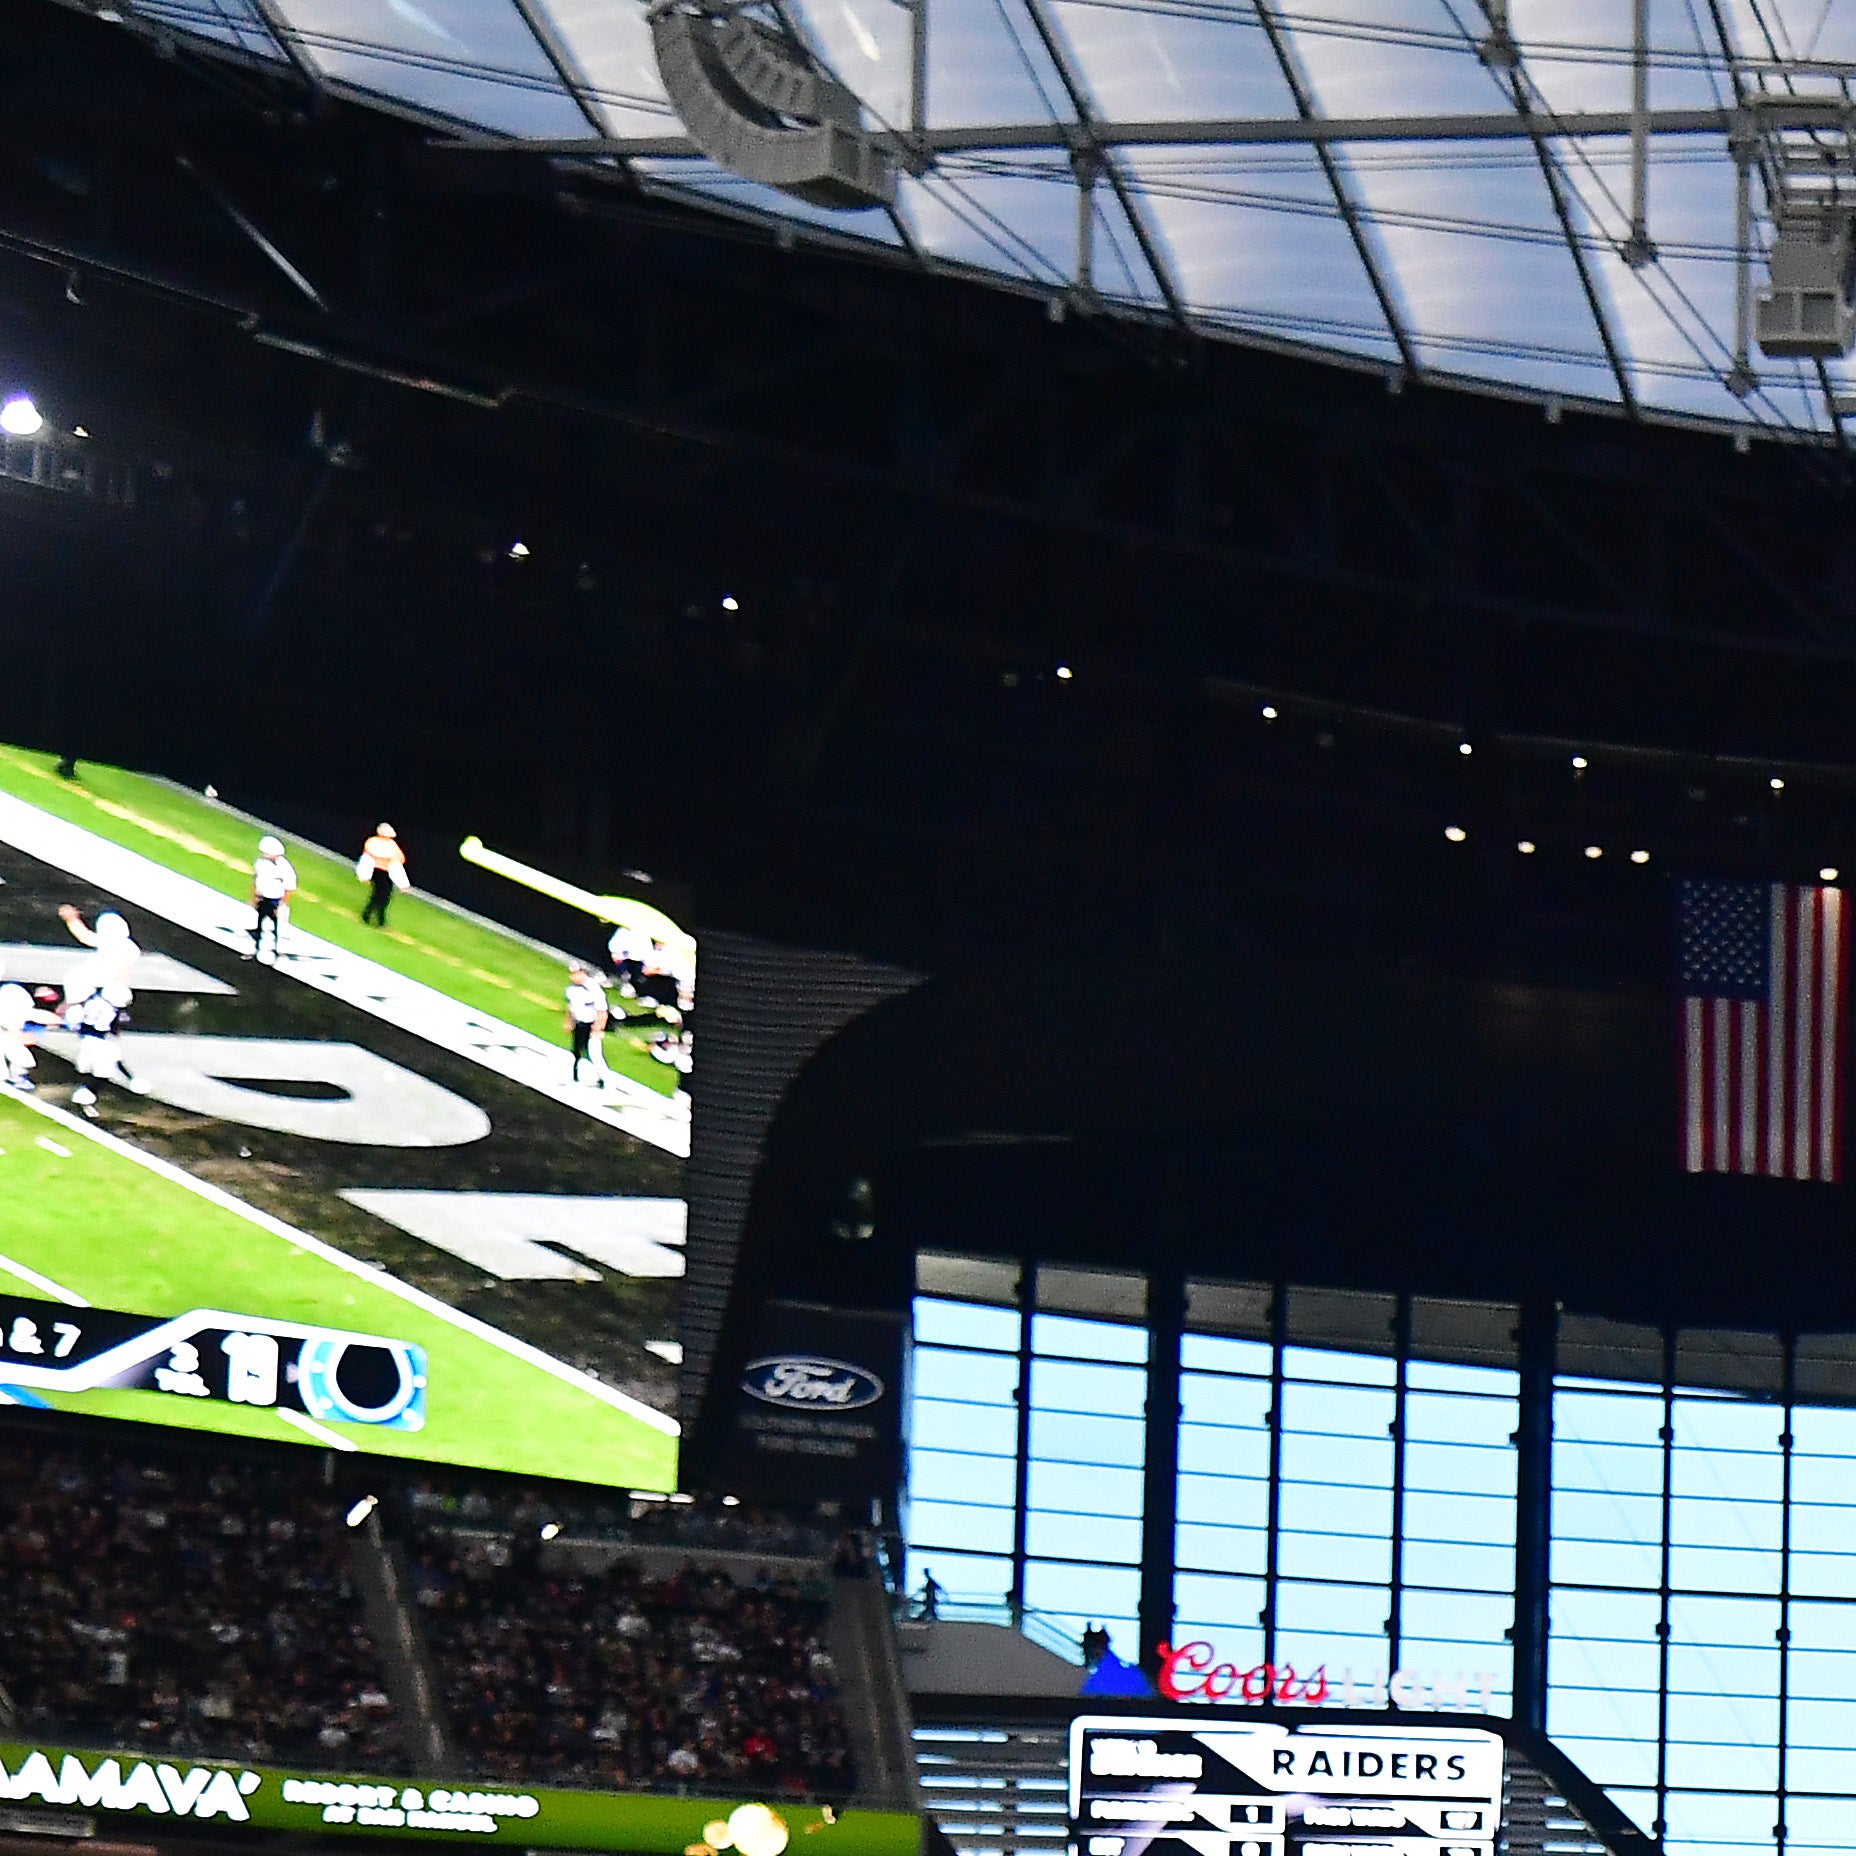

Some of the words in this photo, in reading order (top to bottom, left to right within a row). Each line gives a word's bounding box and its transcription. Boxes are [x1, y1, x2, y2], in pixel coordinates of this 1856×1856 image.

[765, 1365, 856, 1404] Ford
[1157, 1641, 1332, 1702] Coors
[1273, 1749, 1466, 1781] RAIDERS
